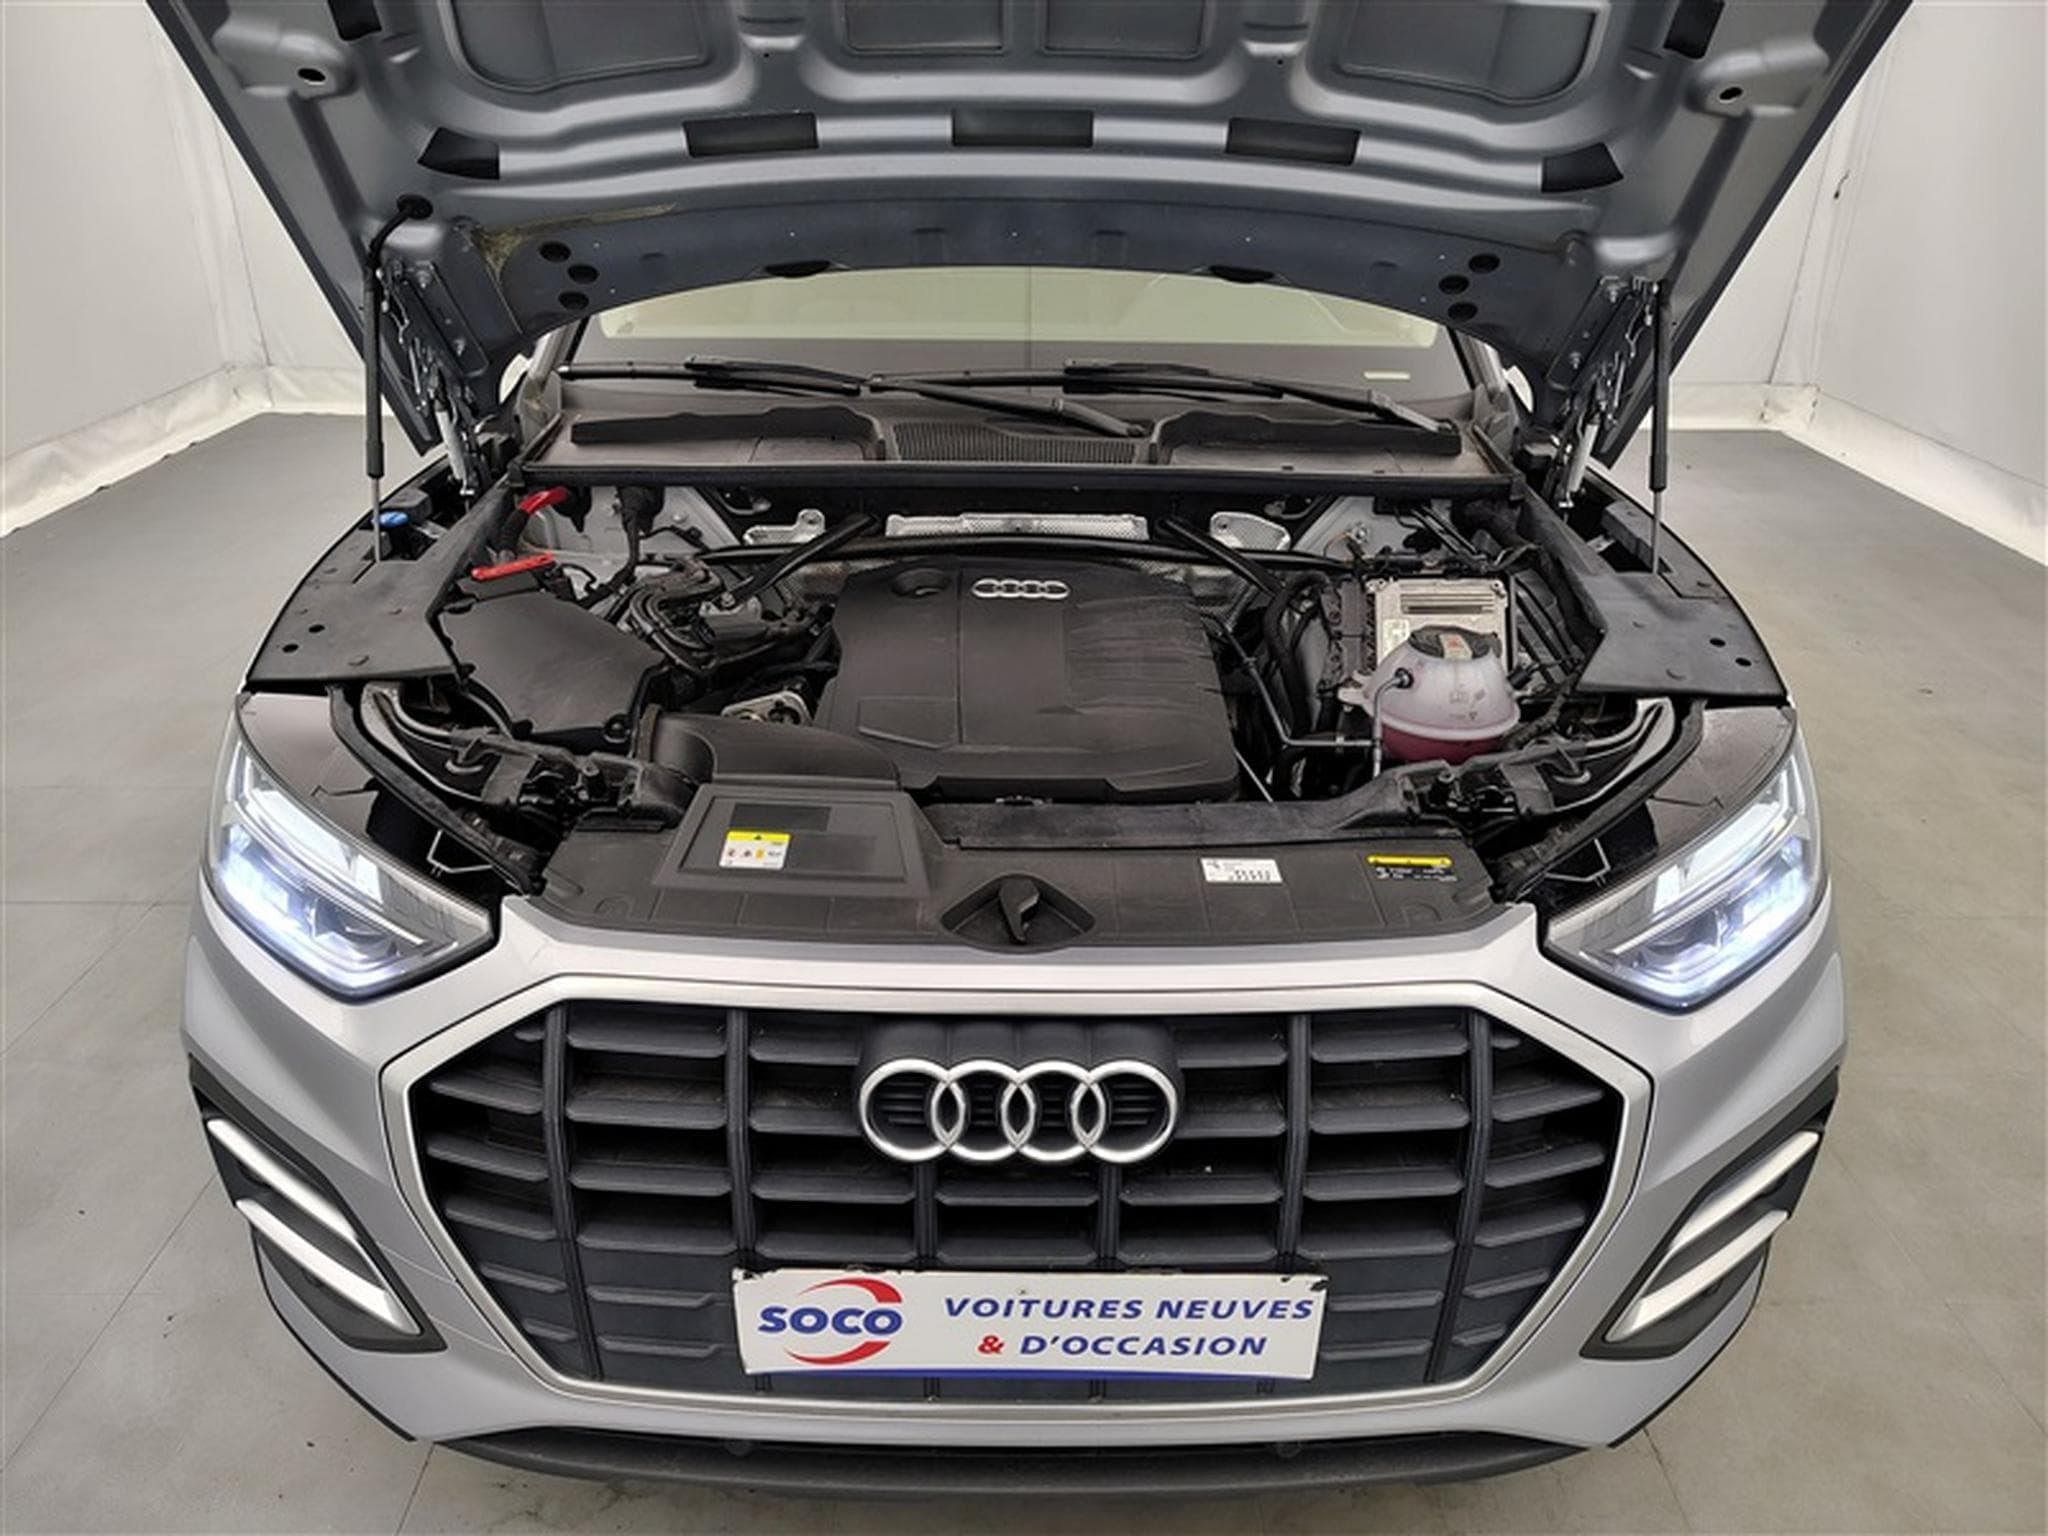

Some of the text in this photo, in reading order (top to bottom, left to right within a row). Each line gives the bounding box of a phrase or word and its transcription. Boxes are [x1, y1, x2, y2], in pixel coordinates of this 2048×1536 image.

[945, 1298, 1313, 1320] VOITURES NEUVES
[758, 1306, 902, 1336] SOCO
[977, 1335, 1267, 1356] & D'OCCASION
